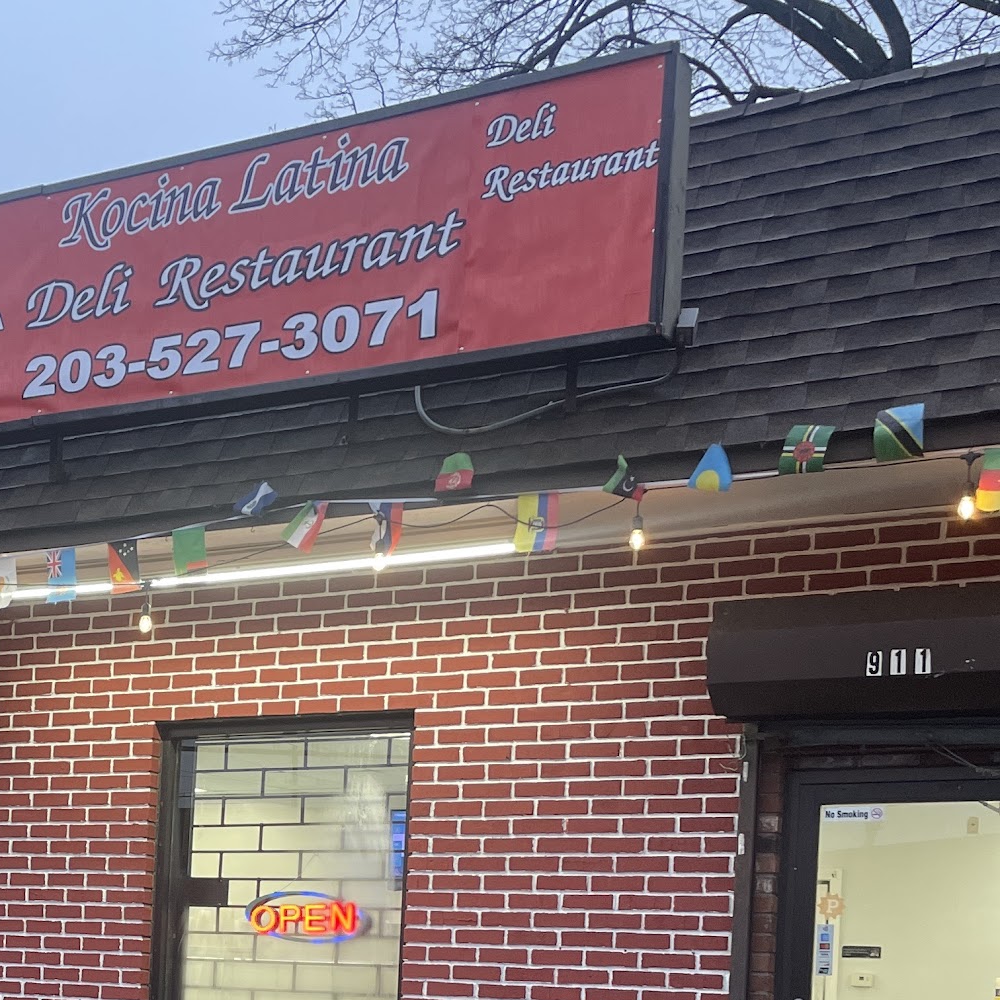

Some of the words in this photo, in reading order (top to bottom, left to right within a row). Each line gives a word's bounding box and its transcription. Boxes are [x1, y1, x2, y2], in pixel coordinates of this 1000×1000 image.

[486, 102, 558, 148] Deli
[58, 173, 222, 251] Kocina
[227, 133, 410, 215] Latina
[481, 140, 660, 202] Restaurant
[25, 263, 134, 329] Deli
[155, 210, 465, 310] Restaurant
[22, 289, 440, 400] 203-527-3071
[867, 649, 930, 676] 911
[825, 810, 835, 818] No
[837, 810, 869, 819] Smoking
[250, 902, 359, 935] OPEN
